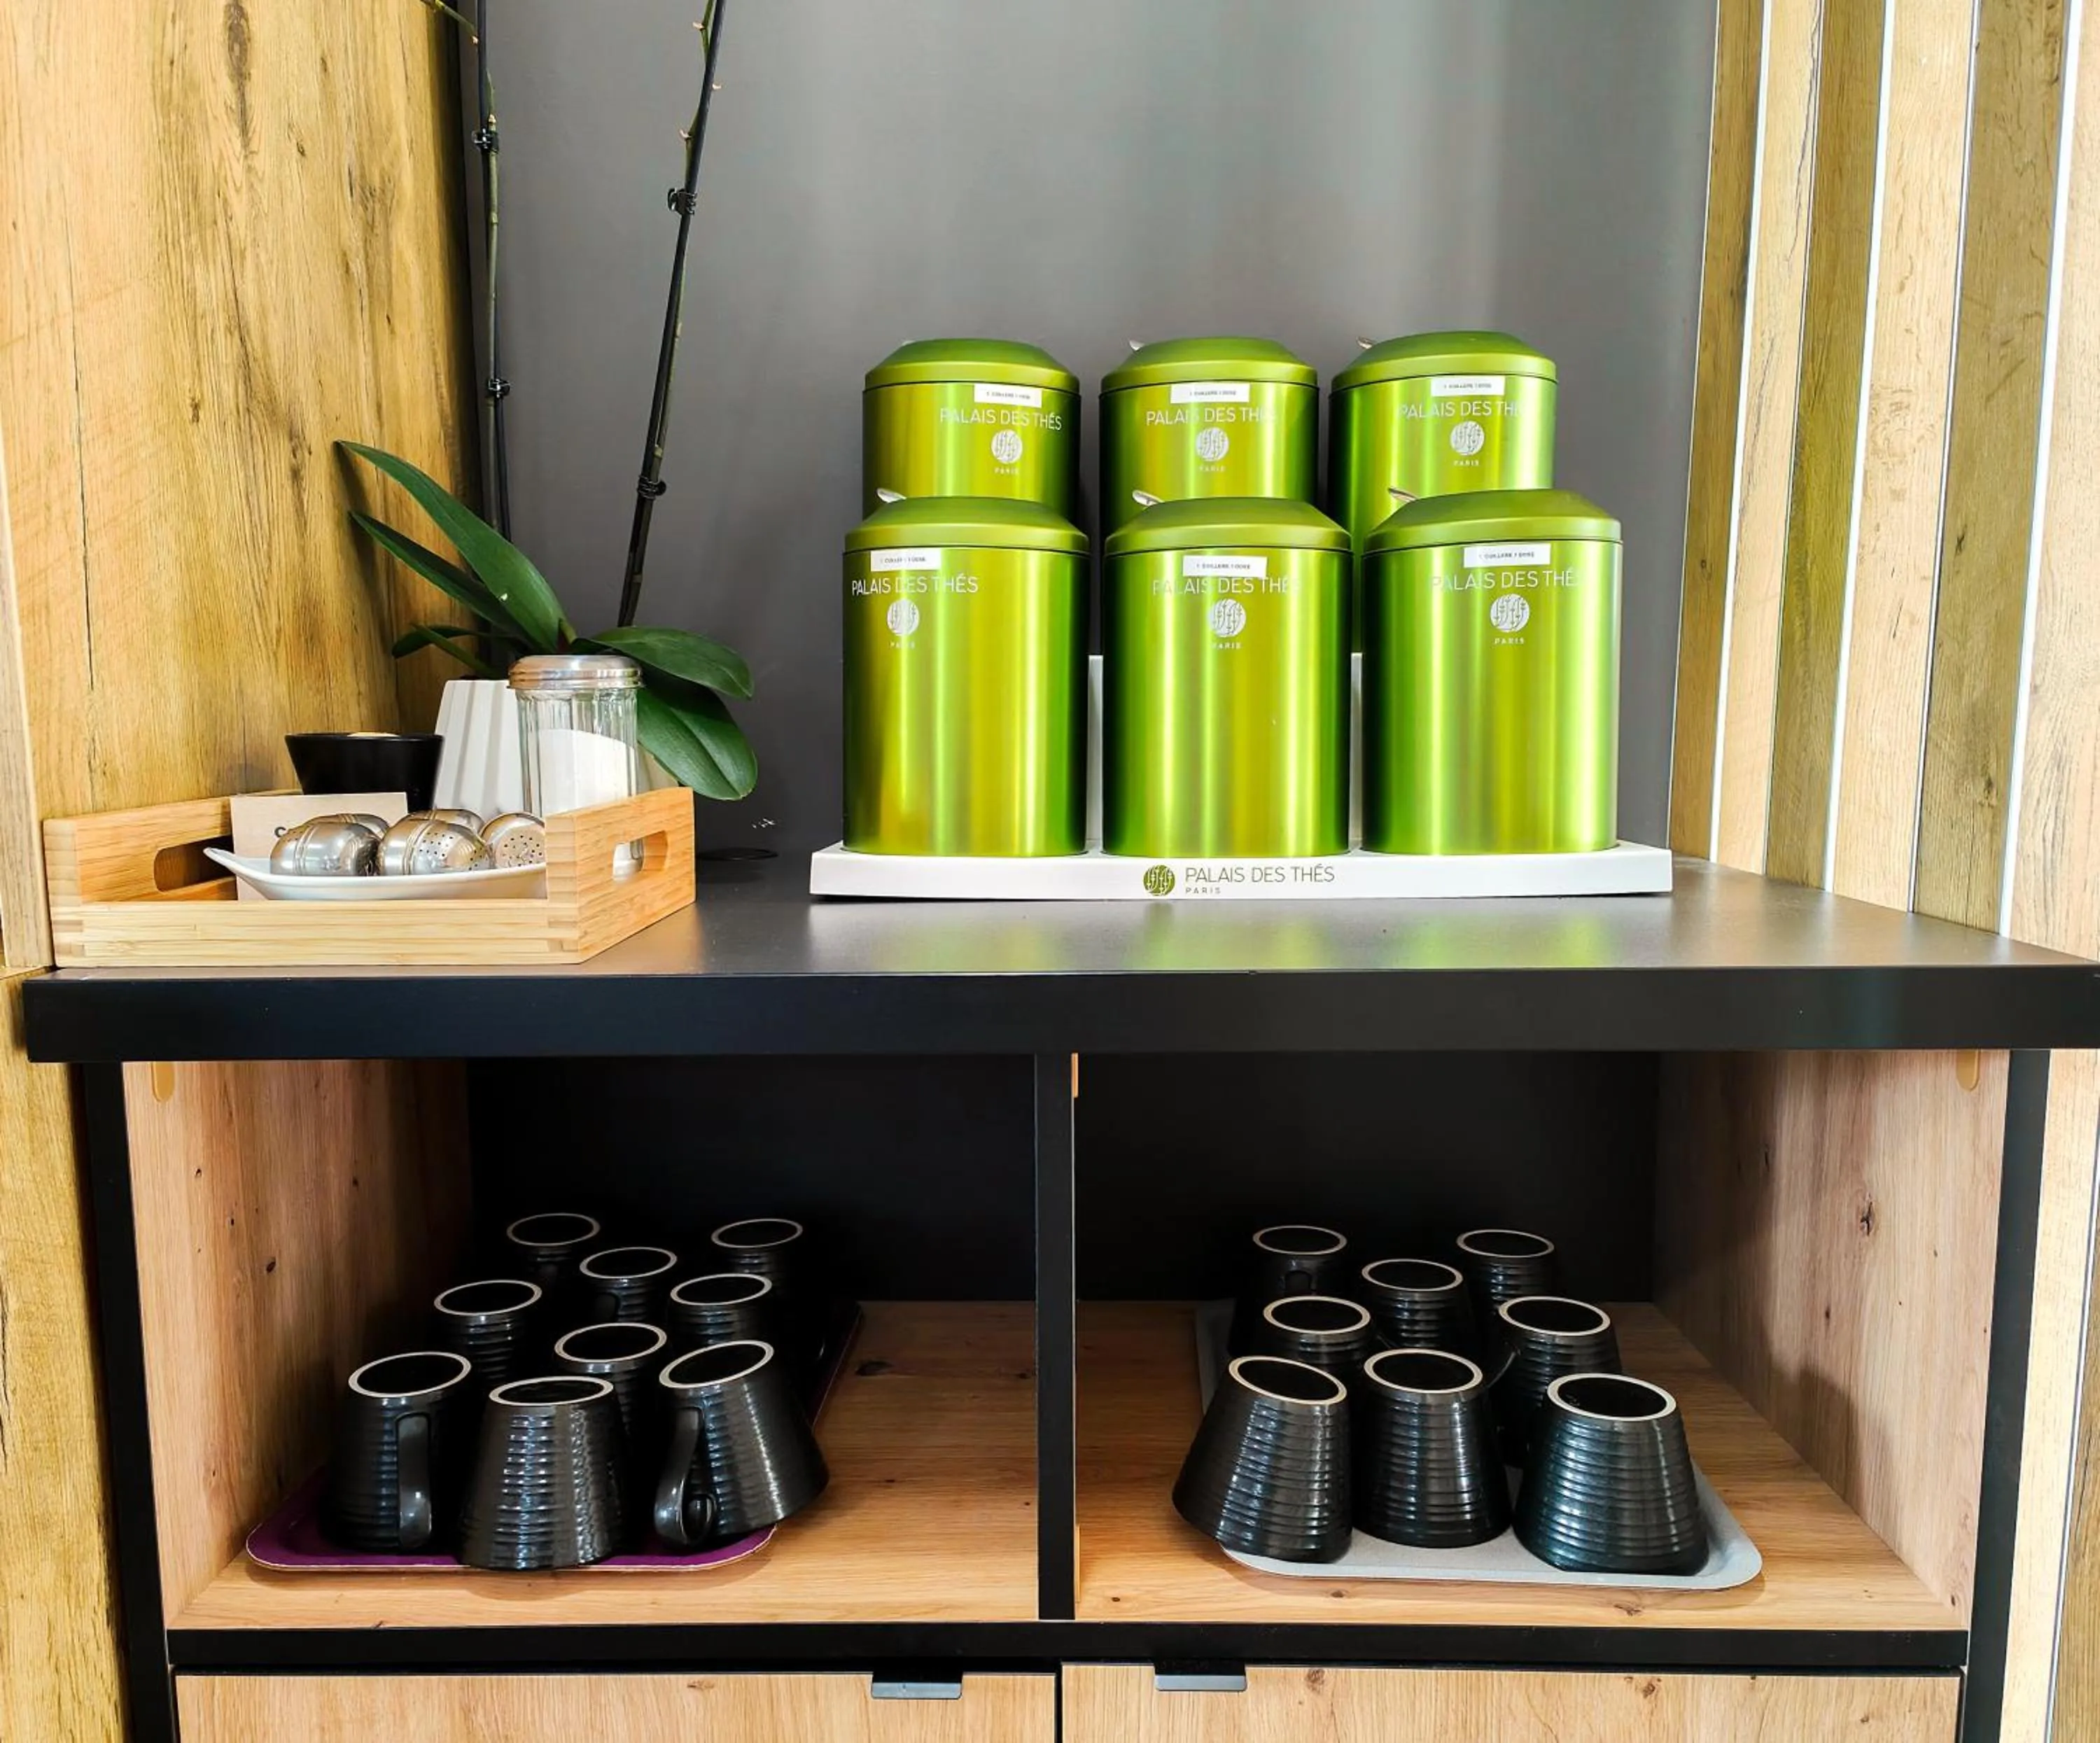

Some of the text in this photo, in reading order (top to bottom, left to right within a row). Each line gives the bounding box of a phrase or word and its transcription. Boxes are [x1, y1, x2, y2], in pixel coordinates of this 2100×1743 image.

[940, 407, 1062, 430] PALAIS DES THÉS
[1204, 407, 1236, 422] DES
[1400, 400, 1521, 419] PALAIS DES TH
[852, 573, 979, 596] PALAIS DES THÉS
[1218, 577, 1255, 594] DES
[1260, 575, 1301, 594] TH
[1432, 567, 1578, 593] PALAIS DES THÉ
[1185, 863, 1335, 883] PALAIS DES THÉS
